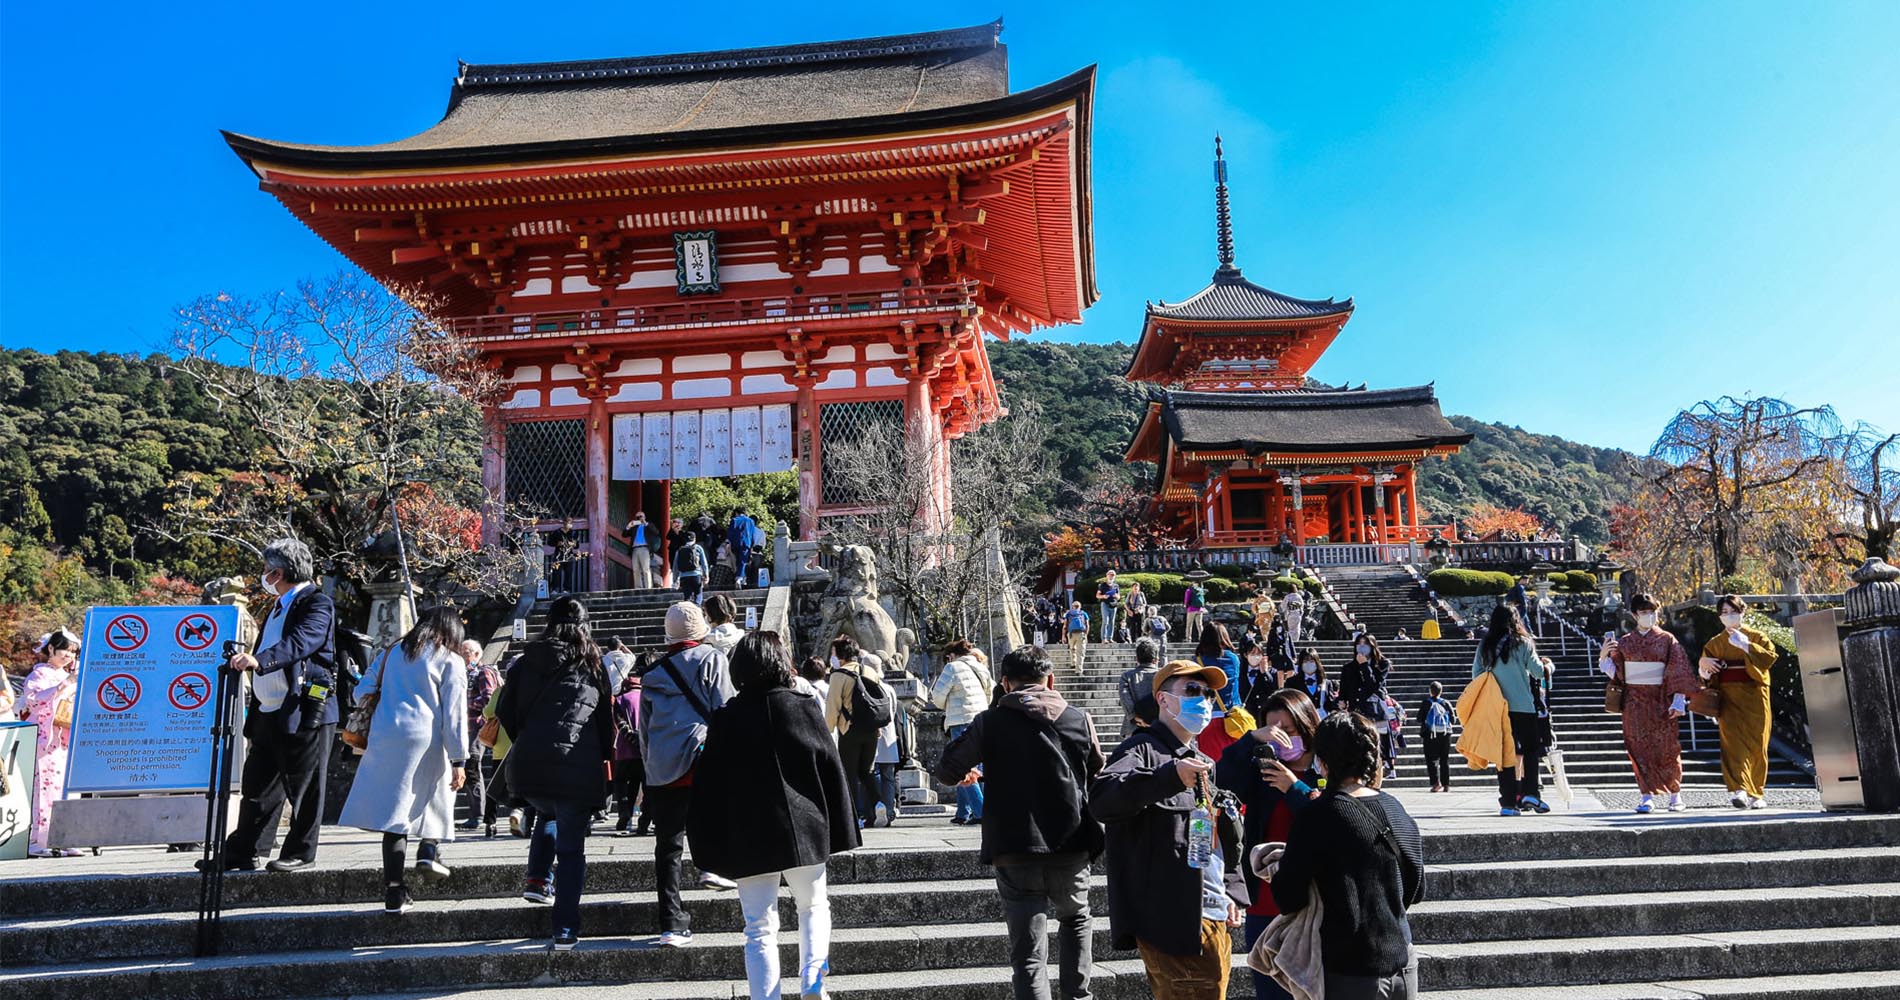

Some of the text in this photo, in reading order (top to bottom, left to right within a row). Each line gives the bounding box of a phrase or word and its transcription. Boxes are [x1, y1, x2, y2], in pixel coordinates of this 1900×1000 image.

[96, 749, 128, 757] Shooting
[143, 749, 155, 757] any
[158, 747, 200, 755] commercial
[148, 755, 187, 763] prohibited
[141, 762, 181, 771] permission.
